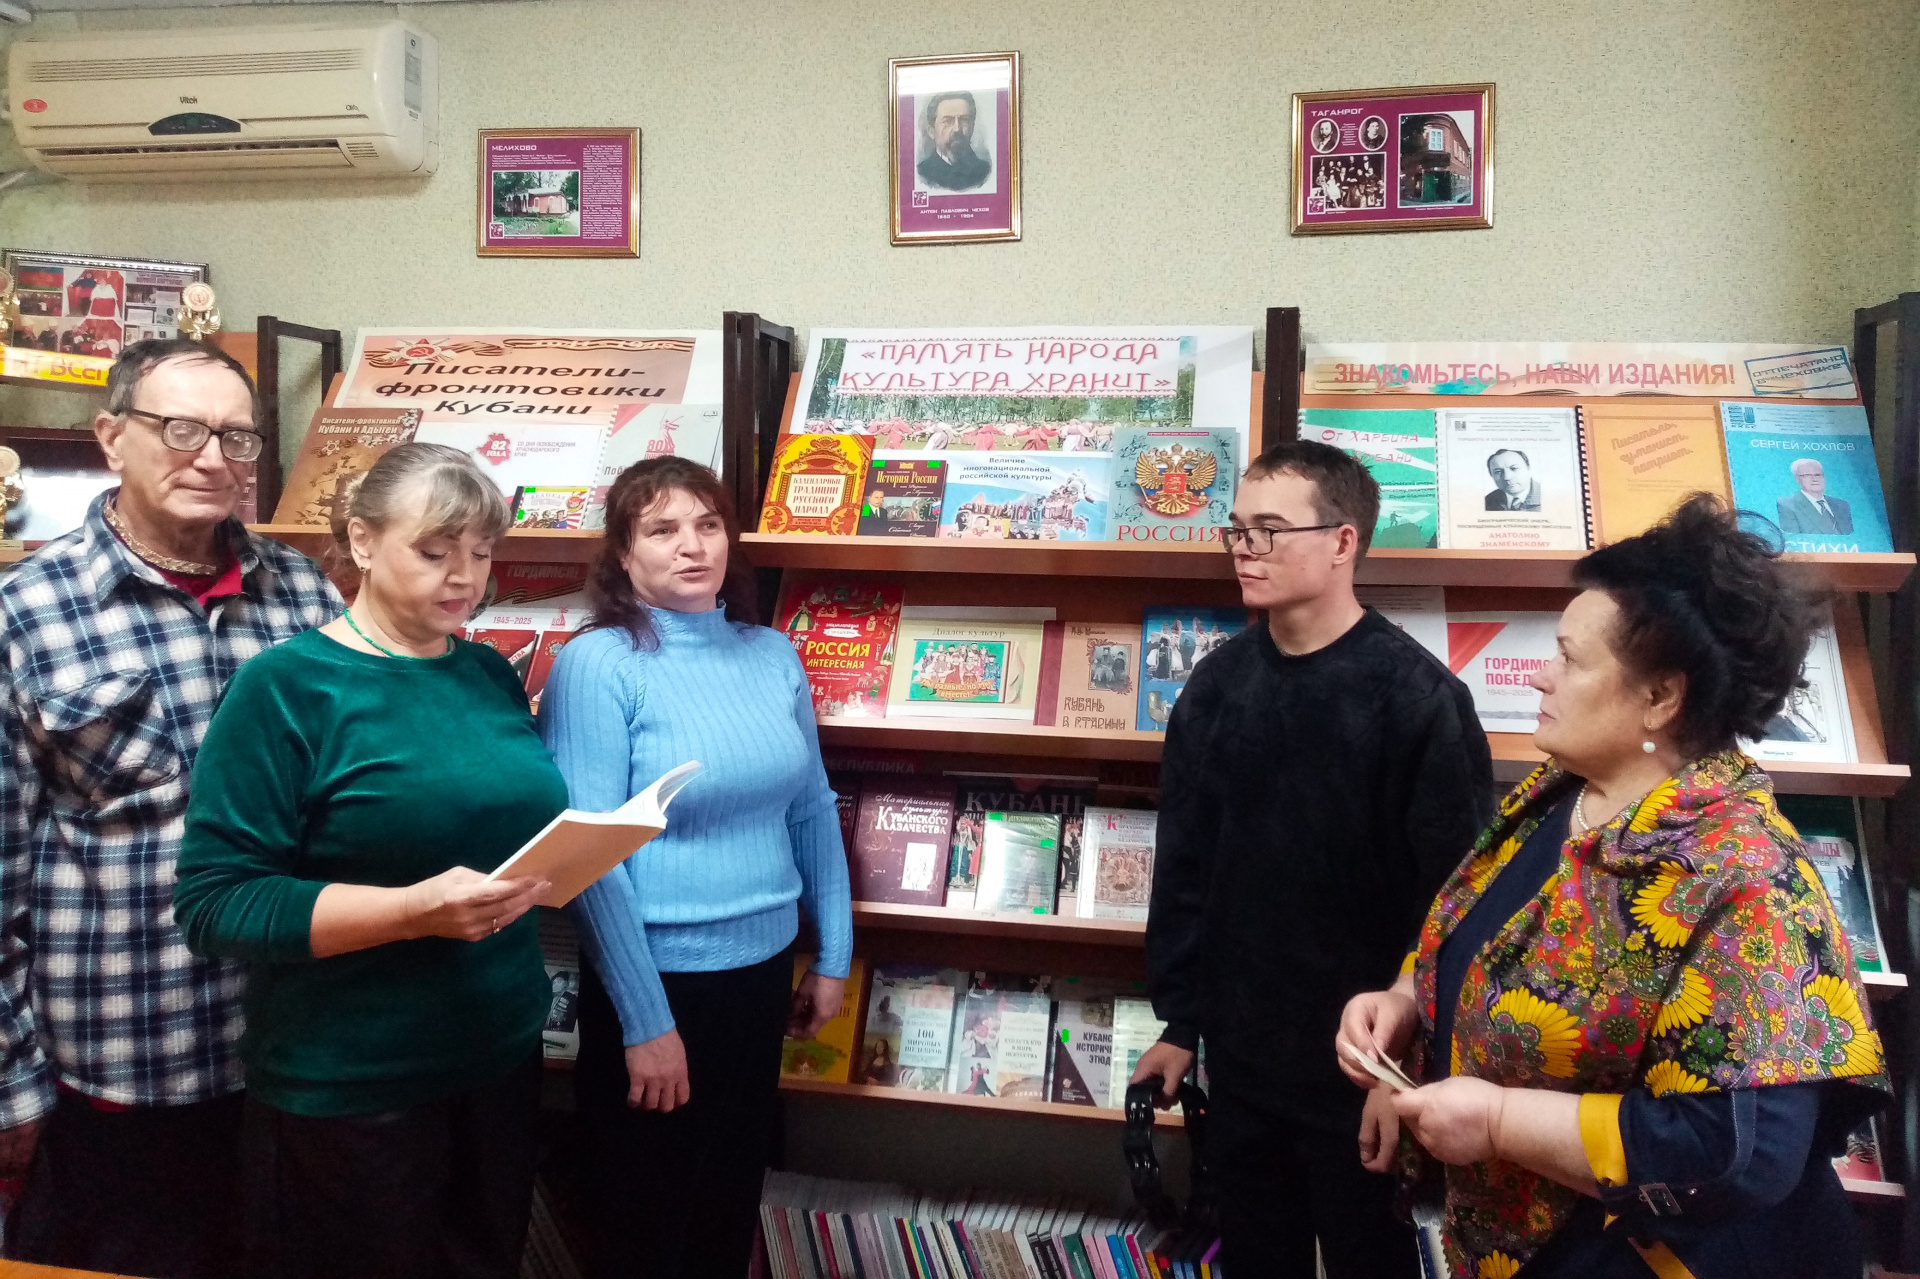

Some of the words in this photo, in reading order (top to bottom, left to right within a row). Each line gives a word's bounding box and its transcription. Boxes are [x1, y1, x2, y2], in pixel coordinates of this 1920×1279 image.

[1311, 107, 1364, 117] ТАГАНРОГ
[861, 343, 1013, 365] «ПАМЯТЬ
[1025, 343, 1158, 365] НАРОДА
[403, 362, 646, 380] Писатели-
[1334, 362, 1517, 388] ЗНАКОМЬТЕСЬ,
[1525, 362, 1600, 385] НАШИ
[1609, 362, 1735, 388] ИЗДАНИЯ!
[840, 371, 1010, 393] КУЛЬТУРА
[1016, 371, 1172, 394] ХРАНИТ»
[375, 381, 667, 398] фронтовики
[433, 400, 593, 416] Кубани
[318, 425, 353, 435] Кубани
[490, 440, 507, 451] 82
[647, 439, 664, 451] 80
[1750, 438, 1800, 450] СЕРГЕЙ
[1802, 442, 1856, 451] ХОХЛОВ
[989, 456, 1026, 465] Величие
[963, 464, 1051, 474] многонациональной
[876, 470, 910, 488] История
[911, 471, 938, 484] России
[959, 472, 1010, 481] российской
[1011, 473, 1052, 482] культуры
[793, 486, 839, 495] ТРАДИЦИИ
[792, 495, 835, 504] РУССКОГО
[794, 505, 829, 514] НАРОДА
[1117, 524, 1223, 543] РОССИЯ
[932, 628, 966, 637] Диалог
[968, 629, 1006, 637] культур
[805, 640, 871, 658] РОССИЯ
[806, 658, 865, 669] ИНТЕРЕСНАЯ
[1485, 657, 1551, 671] ГОРДИМС
[1486, 673, 1532, 687] ПОБЕД
[1063, 697, 1106, 712] КУБАНЬ
[875, 793, 950, 807] Материальная
[902, 805, 949, 817] культура
[917, 1028, 935, 1039] 100
[1083, 1031, 1113, 1043] КУБАНС
[1089, 1054, 1111, 1067] ЭТЮД
